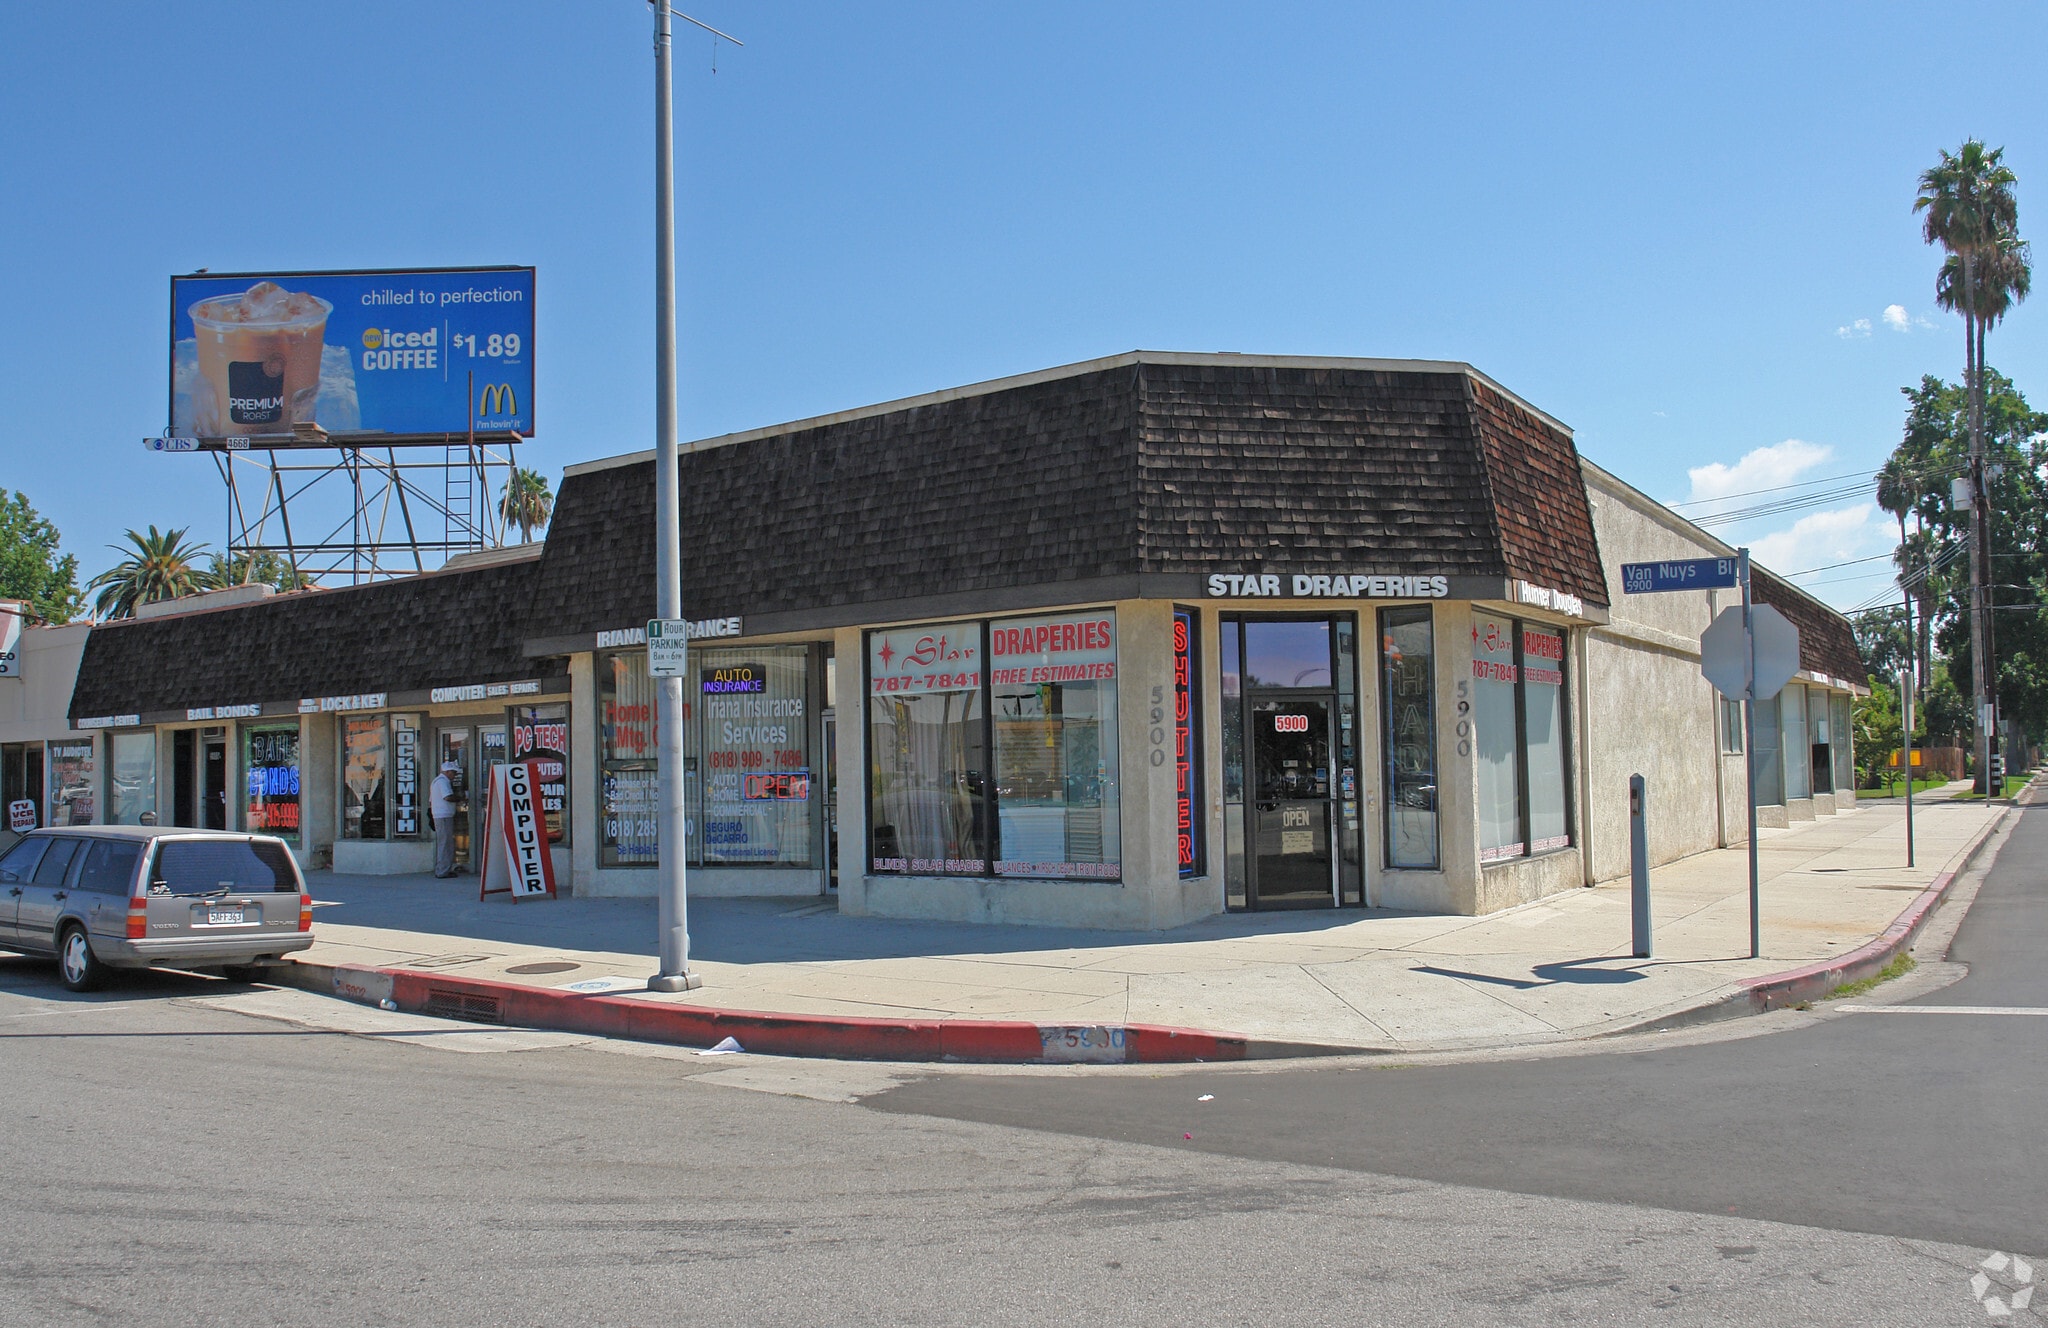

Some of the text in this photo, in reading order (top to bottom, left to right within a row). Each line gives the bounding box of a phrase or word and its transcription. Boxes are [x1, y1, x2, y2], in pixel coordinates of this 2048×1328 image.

[361, 287, 523, 307] chilled to perfection
[383, 327, 438, 348] iced
[453, 333, 521, 357] $1.89
[362, 349, 438, 371] COFFEE
[229, 396, 284, 410] PREMIUM
[243, 411, 271, 420] ROAST
[165, 438, 191, 450] CBS
[228, 438, 248, 449] 4668
[1627, 559, 1732, 582] Van Nuys Bl
[1208, 574, 1448, 598] STAR DRAPERIES
[1627, 580, 1652, 592] 5900
[1521, 580, 1583, 616] Hunter Douglas
[597, 627, 647, 648] IRIANA
[652, 622, 684, 635] 1 HOUR
[993, 620, 1111, 656] DRAPERIES
[1482, 622, 1511, 652] Star
[650, 638, 685, 650] PARKING
[901, 634, 975, 672] Star
[714, 669, 752, 682] AUTO
[992, 662, 1115, 685] FREE ESTIMATES
[1472, 659, 1518, 684] 787-7841
[704, 680, 762, 692] INSURANCE
[873, 672, 980, 692] 787-7841
[321, 696, 352, 712] LOCK
[361, 692, 387, 710] KEY
[431, 682, 539, 703] COMPUTER SALES REPAIRS
[187, 704, 260, 721] BAIL BONDS
[606, 702, 649, 722] Home
[708, 697, 803, 719] Iriana Insurance
[1150, 685, 1165, 767] 5900
[1276, 716, 1307, 731] 5900
[1457, 681, 1471, 757] 5900
[486, 734, 505, 747] 5904
[515, 724, 566, 760] PC TECH
[616, 726, 648, 753] Mtg.
[724, 720, 787, 745] Services
[1174, 621, 1192, 863] SHUTTER
[255, 735, 292, 763] BAIL
[709, 751, 738, 768] (818)
[742, 751, 763, 768] 909
[774, 750, 802, 767] 7486
[249, 766, 299, 796] BONDS
[397, 719, 416, 832] LOCKSMITH
[713, 774, 737, 787] AUTO
[713, 789, 739, 801] HOME
[744, 774, 806, 799] OPEN
[713, 803, 768, 817] COMMERCIAL
[1283, 810, 1310, 826] OPEN
[13, 818, 34, 827] REPAIR
[510, 767, 543, 892] COMPUTER
[607, 820, 634, 838] (818)
[637, 820, 657, 837] 285
[706, 822, 742, 833] SEGURO
[617, 843, 626, 855] Se
[629, 844, 651, 855] Habla
[873, 858, 985, 872] BLINDS SOLAR SHADES
[993, 861, 1031, 873] VALANCES
[1097, 864, 1120, 876] RODS
